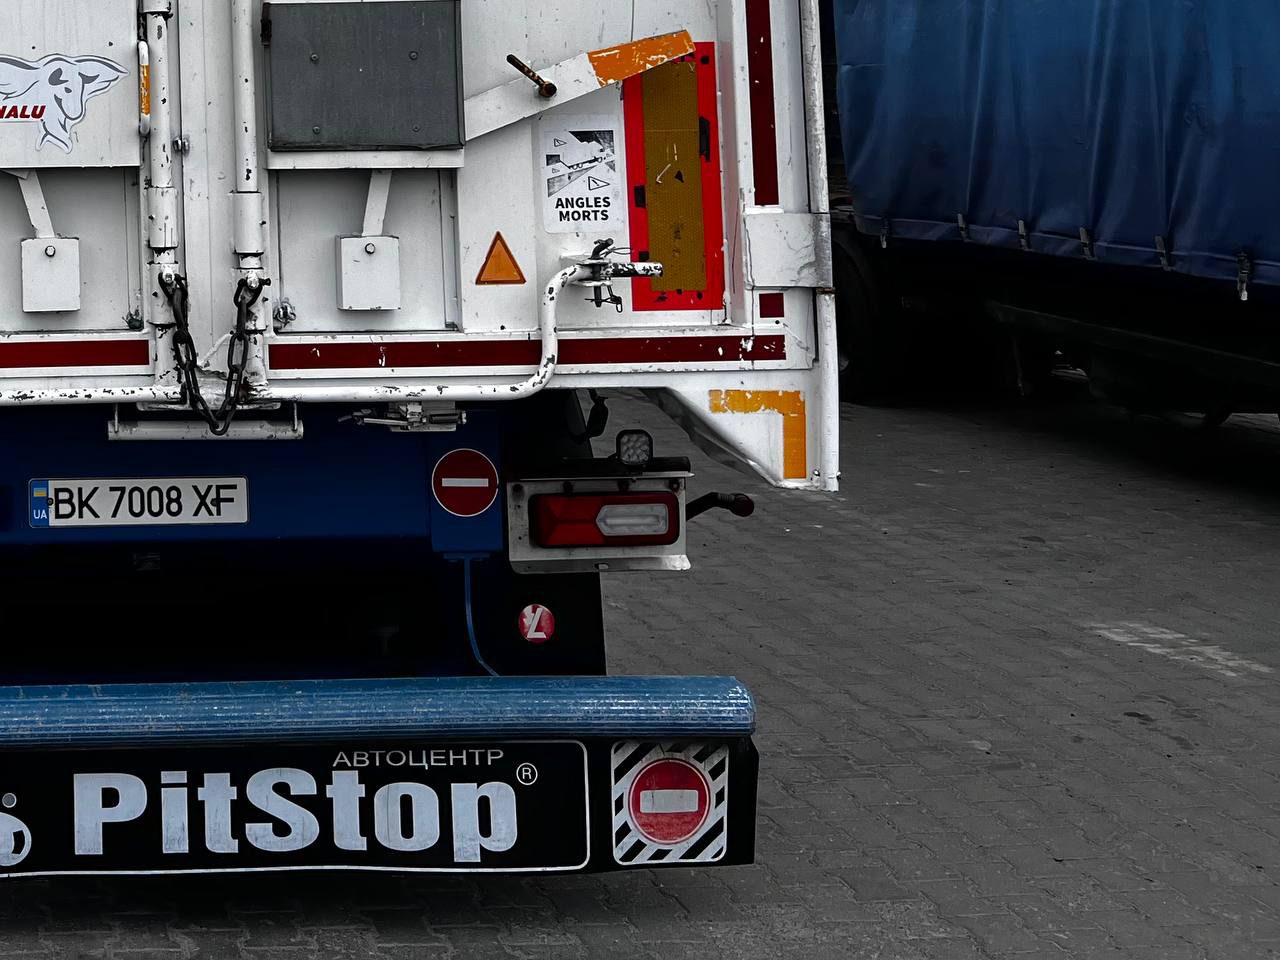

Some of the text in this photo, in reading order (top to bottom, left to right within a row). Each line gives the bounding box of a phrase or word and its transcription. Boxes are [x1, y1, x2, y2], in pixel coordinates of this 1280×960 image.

[555, 196, 611, 209] ANGLES
[559, 209, 609, 222] MORTS
[33, 484, 238, 520] UA BK 7008 XF
[332, 749, 504, 770] АВТОЦЕНТР
[73, 767, 518, 863] PitStop
